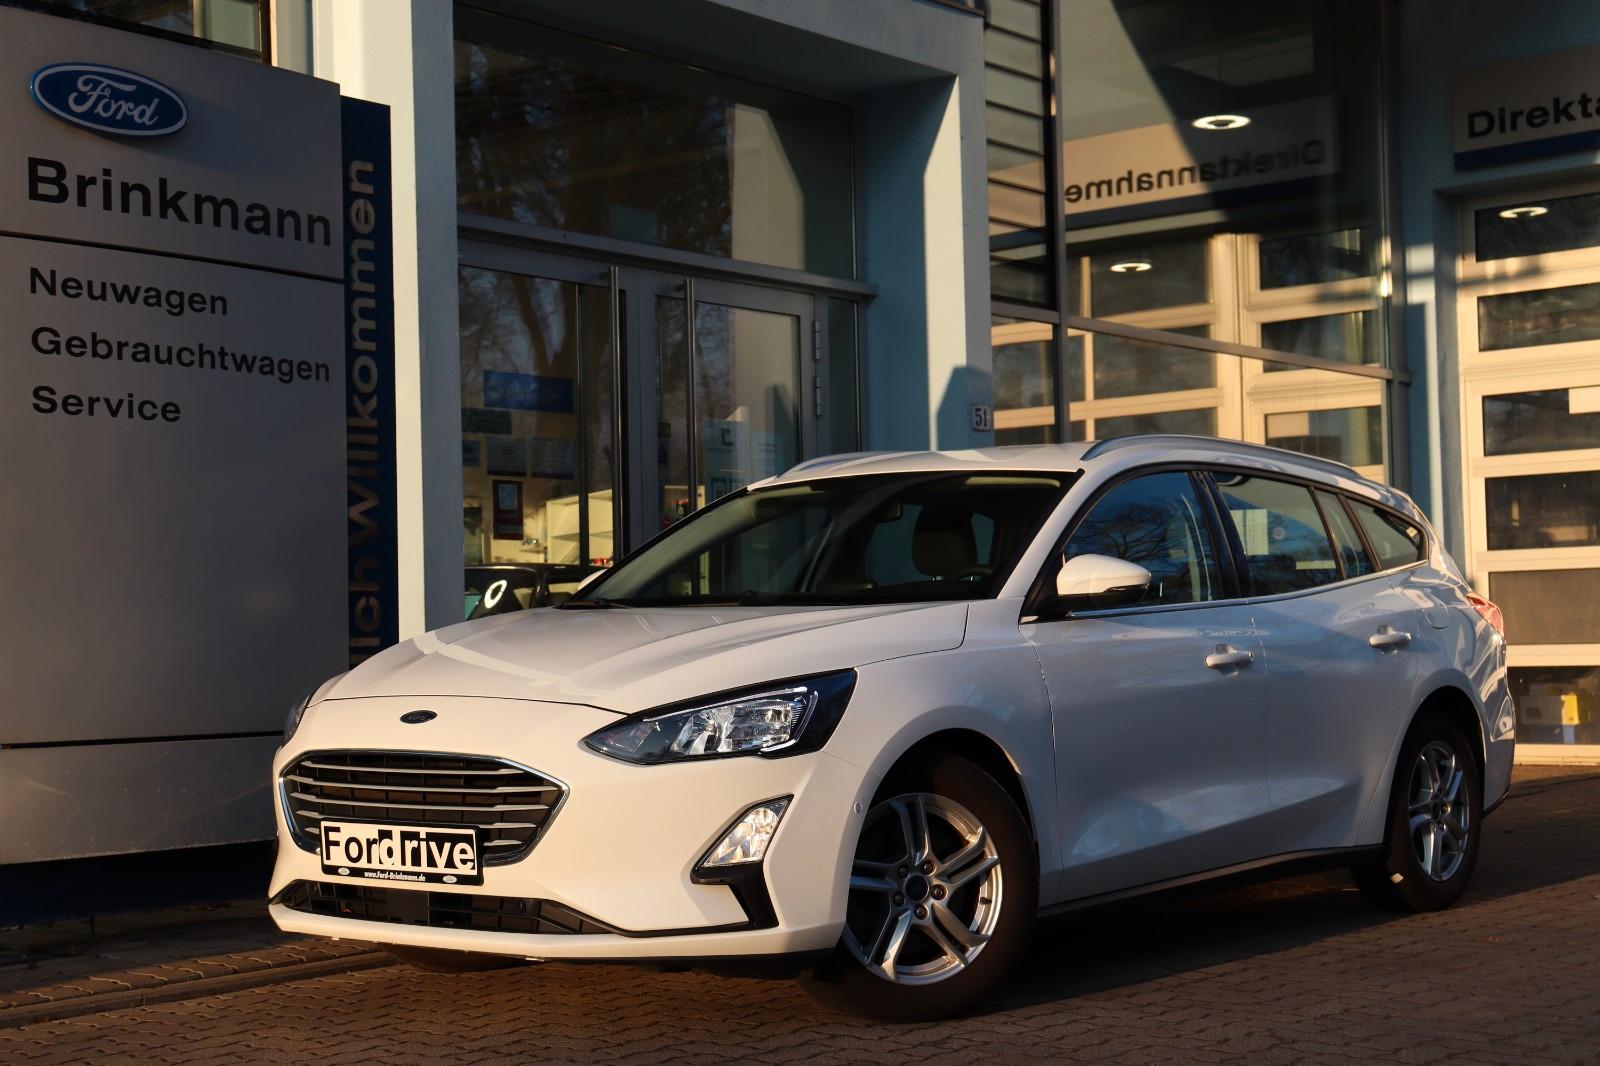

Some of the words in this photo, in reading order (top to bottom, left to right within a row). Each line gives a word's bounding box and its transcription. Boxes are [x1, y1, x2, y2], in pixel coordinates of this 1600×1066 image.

[68, 73, 161, 126] Ford
[1467, 92, 1600, 139] Direkt
[27, 156, 331, 247] Brinkmann
[29, 266, 228, 316] Neuwagen
[31, 326, 330, 383] Gebrauchtwagen
[347, 159, 378, 546] Willkommen
[31, 385, 182, 423] Service
[975, 407, 988, 427] 51
[324, 826, 474, 870] Fordrive
